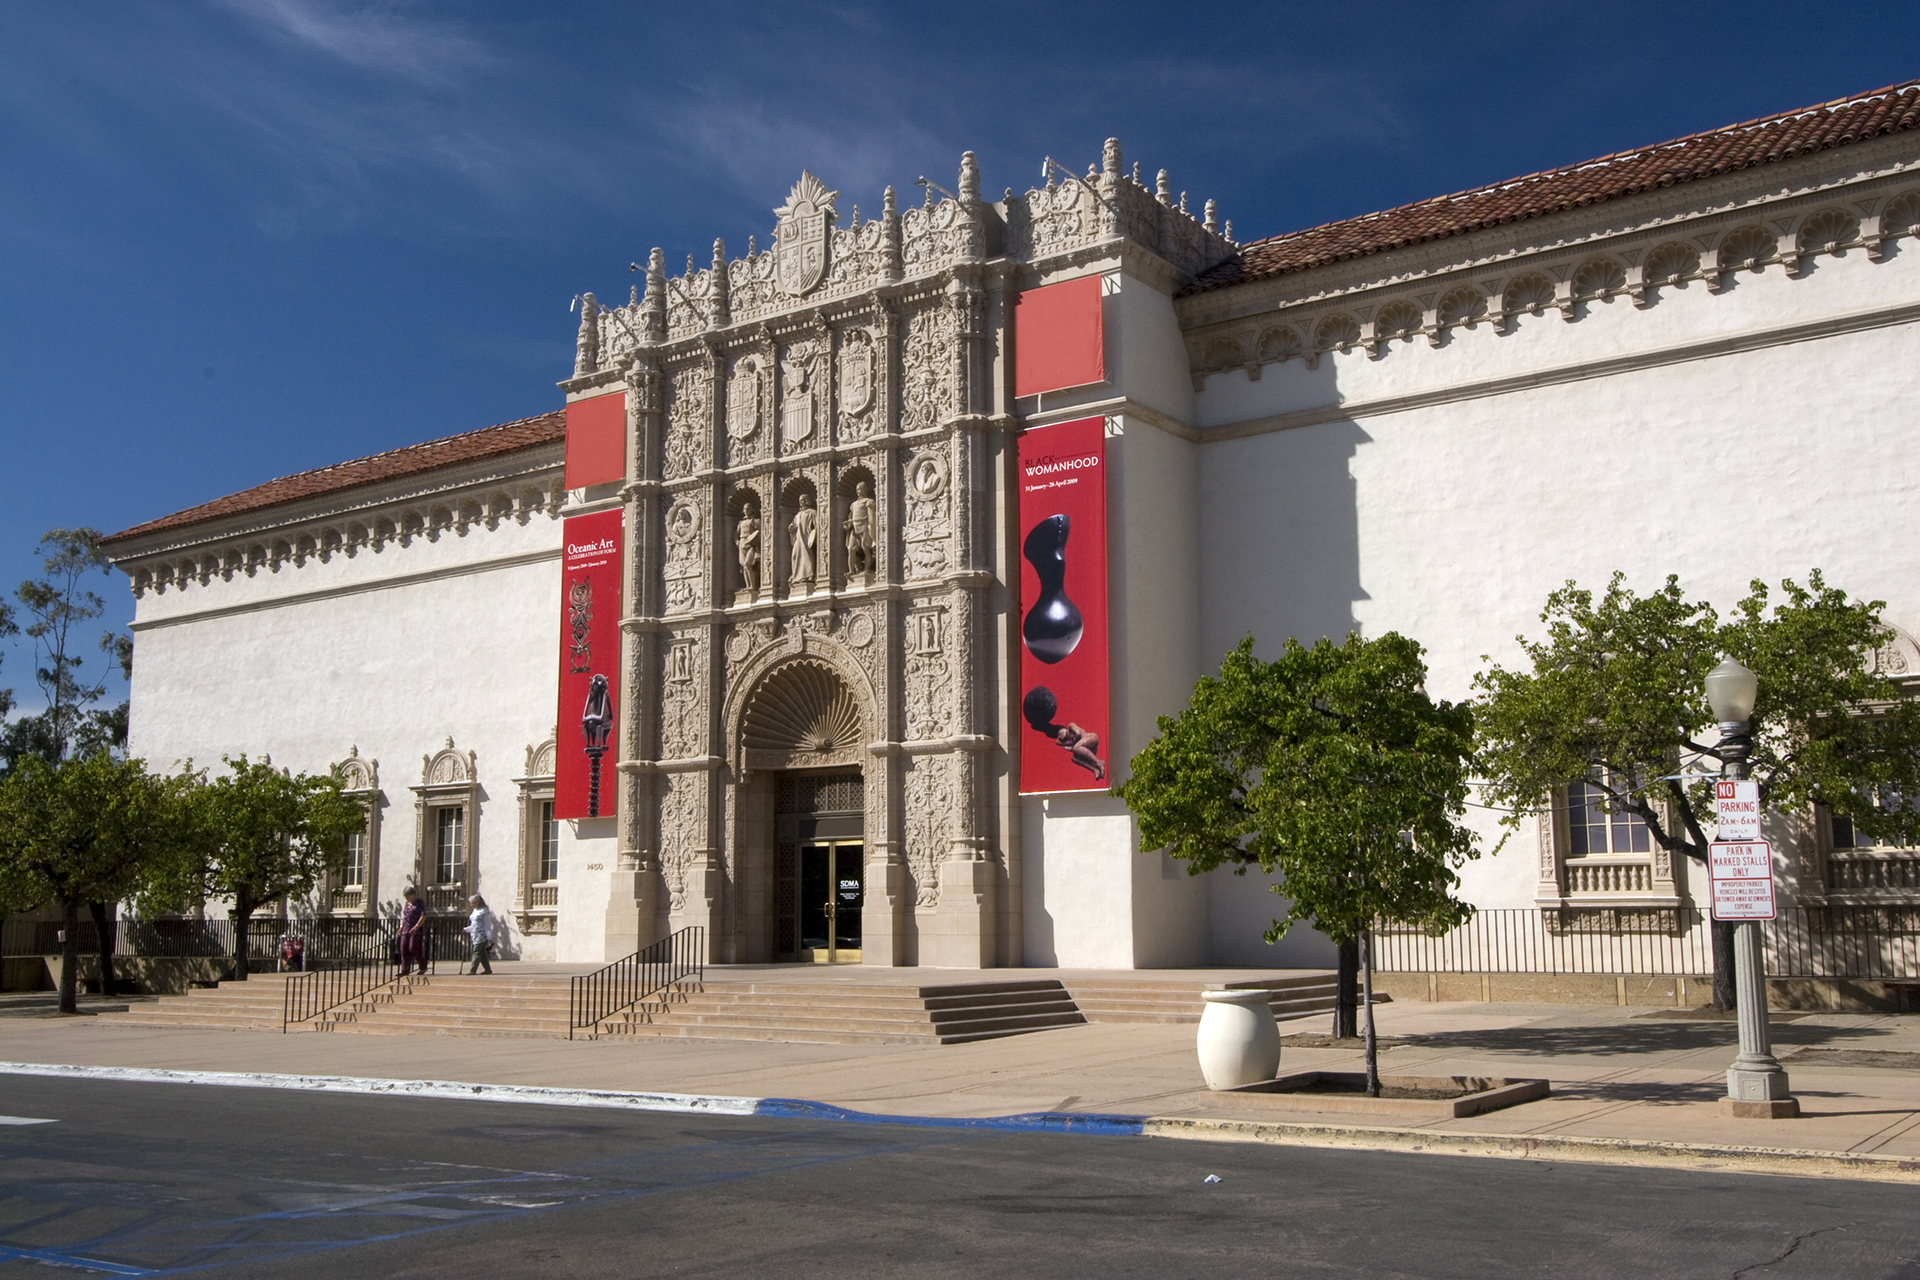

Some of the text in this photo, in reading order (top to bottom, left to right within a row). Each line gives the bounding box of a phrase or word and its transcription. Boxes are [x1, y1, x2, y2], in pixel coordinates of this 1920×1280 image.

[1025, 455, 1055, 468] BLACK
[1025, 456, 1098, 477] WOMANHOOD
[568, 538, 613, 555] Oceanic Art
[1719, 783, 1733, 797] NO
[1720, 801, 1755, 812] PARKING
[1726, 846, 1752, 855] PARK IN
[1714, 856, 1767, 866] MARKED STALLS
[1733, 868, 1749, 877] ONLY
